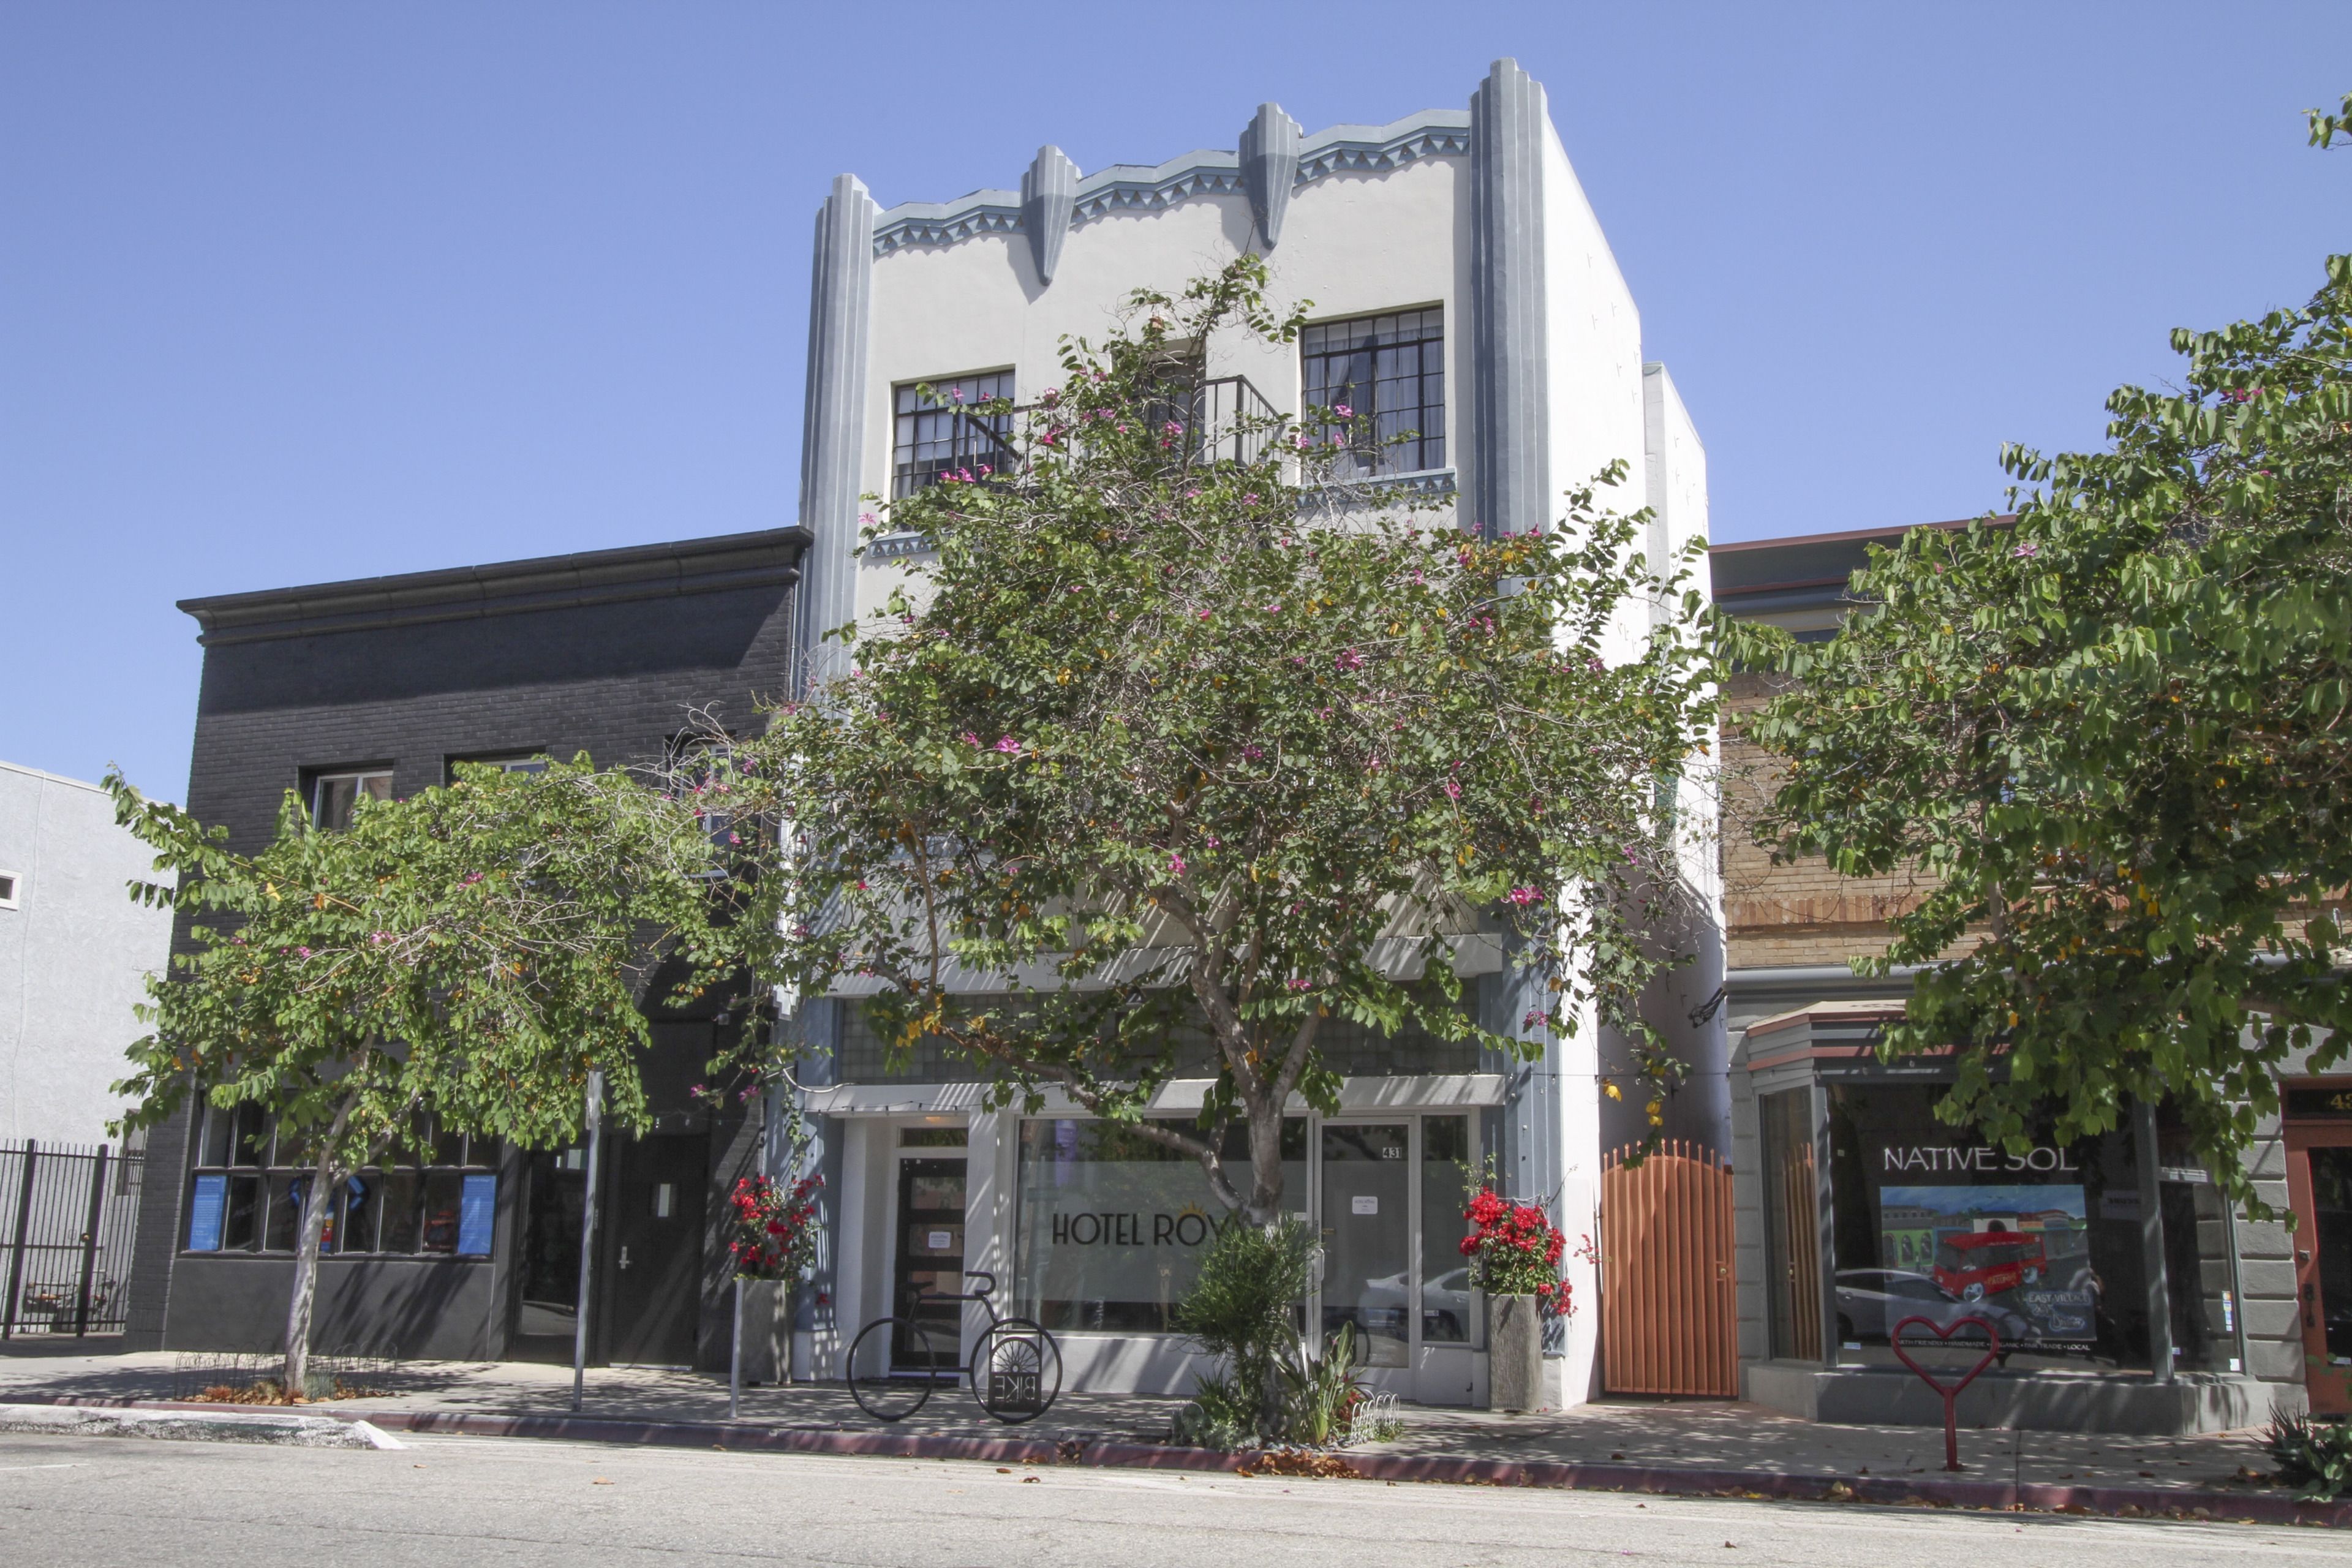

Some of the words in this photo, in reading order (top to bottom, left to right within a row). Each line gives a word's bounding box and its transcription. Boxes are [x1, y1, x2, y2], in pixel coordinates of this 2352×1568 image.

[1383, 1148, 1401, 1158] 431
[1884, 1147, 1997, 1170] NATIVE
[2004, 1147, 2079, 1170] SOL
[1052, 1213, 1145, 1245] HOTEL
[2029, 1293, 2052, 1303] EAST
